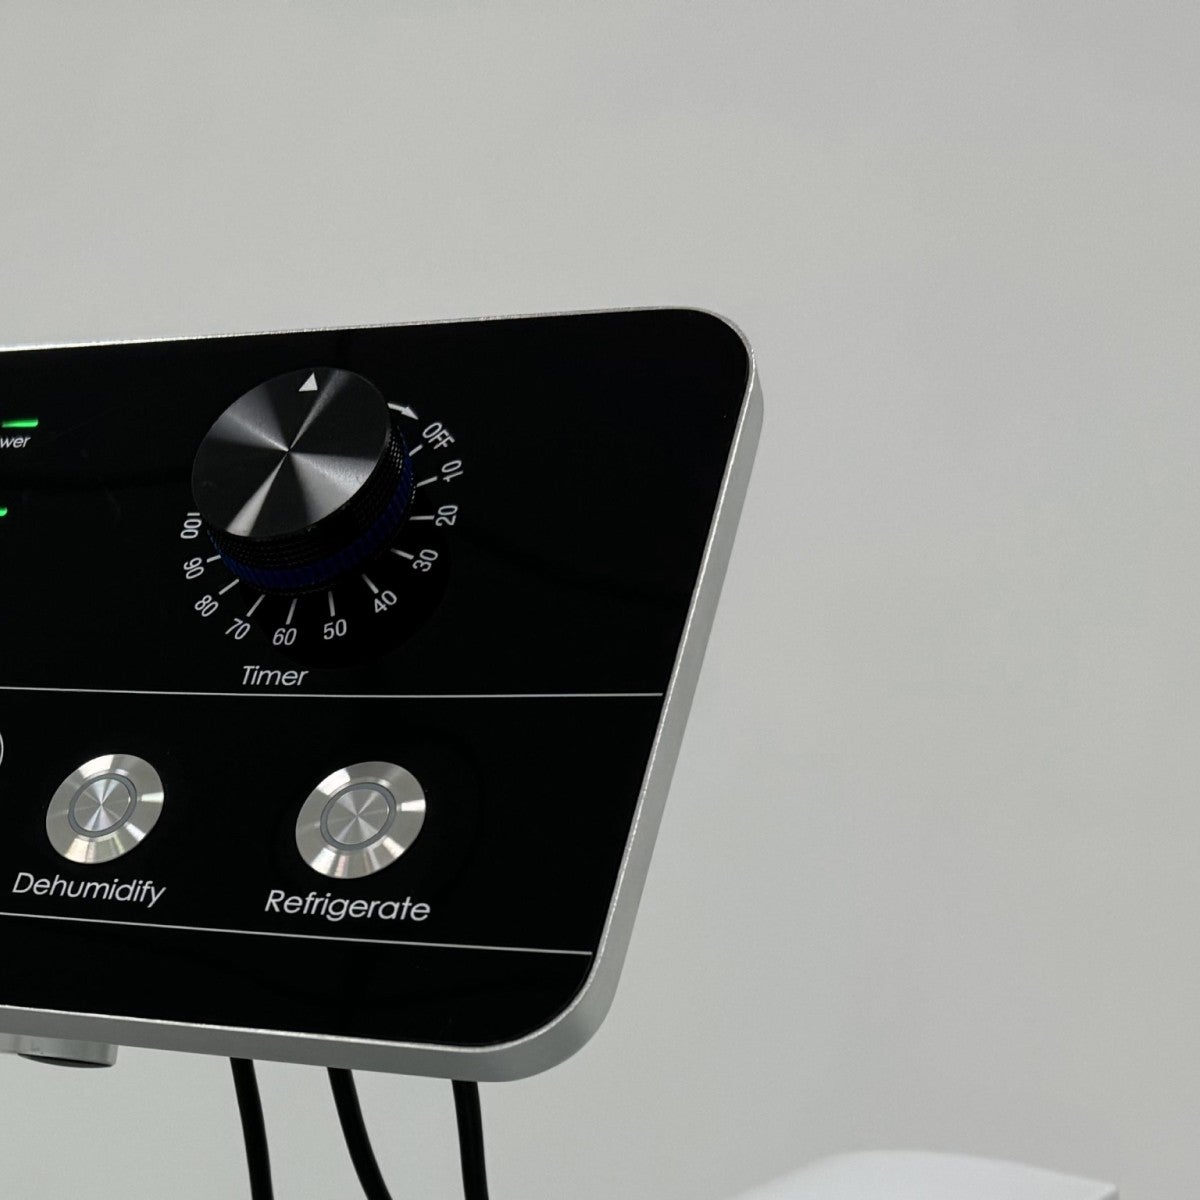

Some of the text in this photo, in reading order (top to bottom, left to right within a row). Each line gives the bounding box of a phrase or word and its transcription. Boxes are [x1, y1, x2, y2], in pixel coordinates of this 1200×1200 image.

[422, 422, 455, 450] OFF
[441, 460, 463, 482] 10
[435, 505, 458, 526] 20
[183, 557, 204, 579] 90
[412, 549, 438, 572] 30
[194, 595, 219, 617] 80
[373, 590, 397, 613] 40
[225, 618, 251, 640] 70
[272, 628, 297, 645] 60
[323, 618, 347, 640] 50
[243, 665, 309, 686] Timer
[12, 872, 166, 908] Dehumidify
[265, 890, 430, 921] Refrigerate
